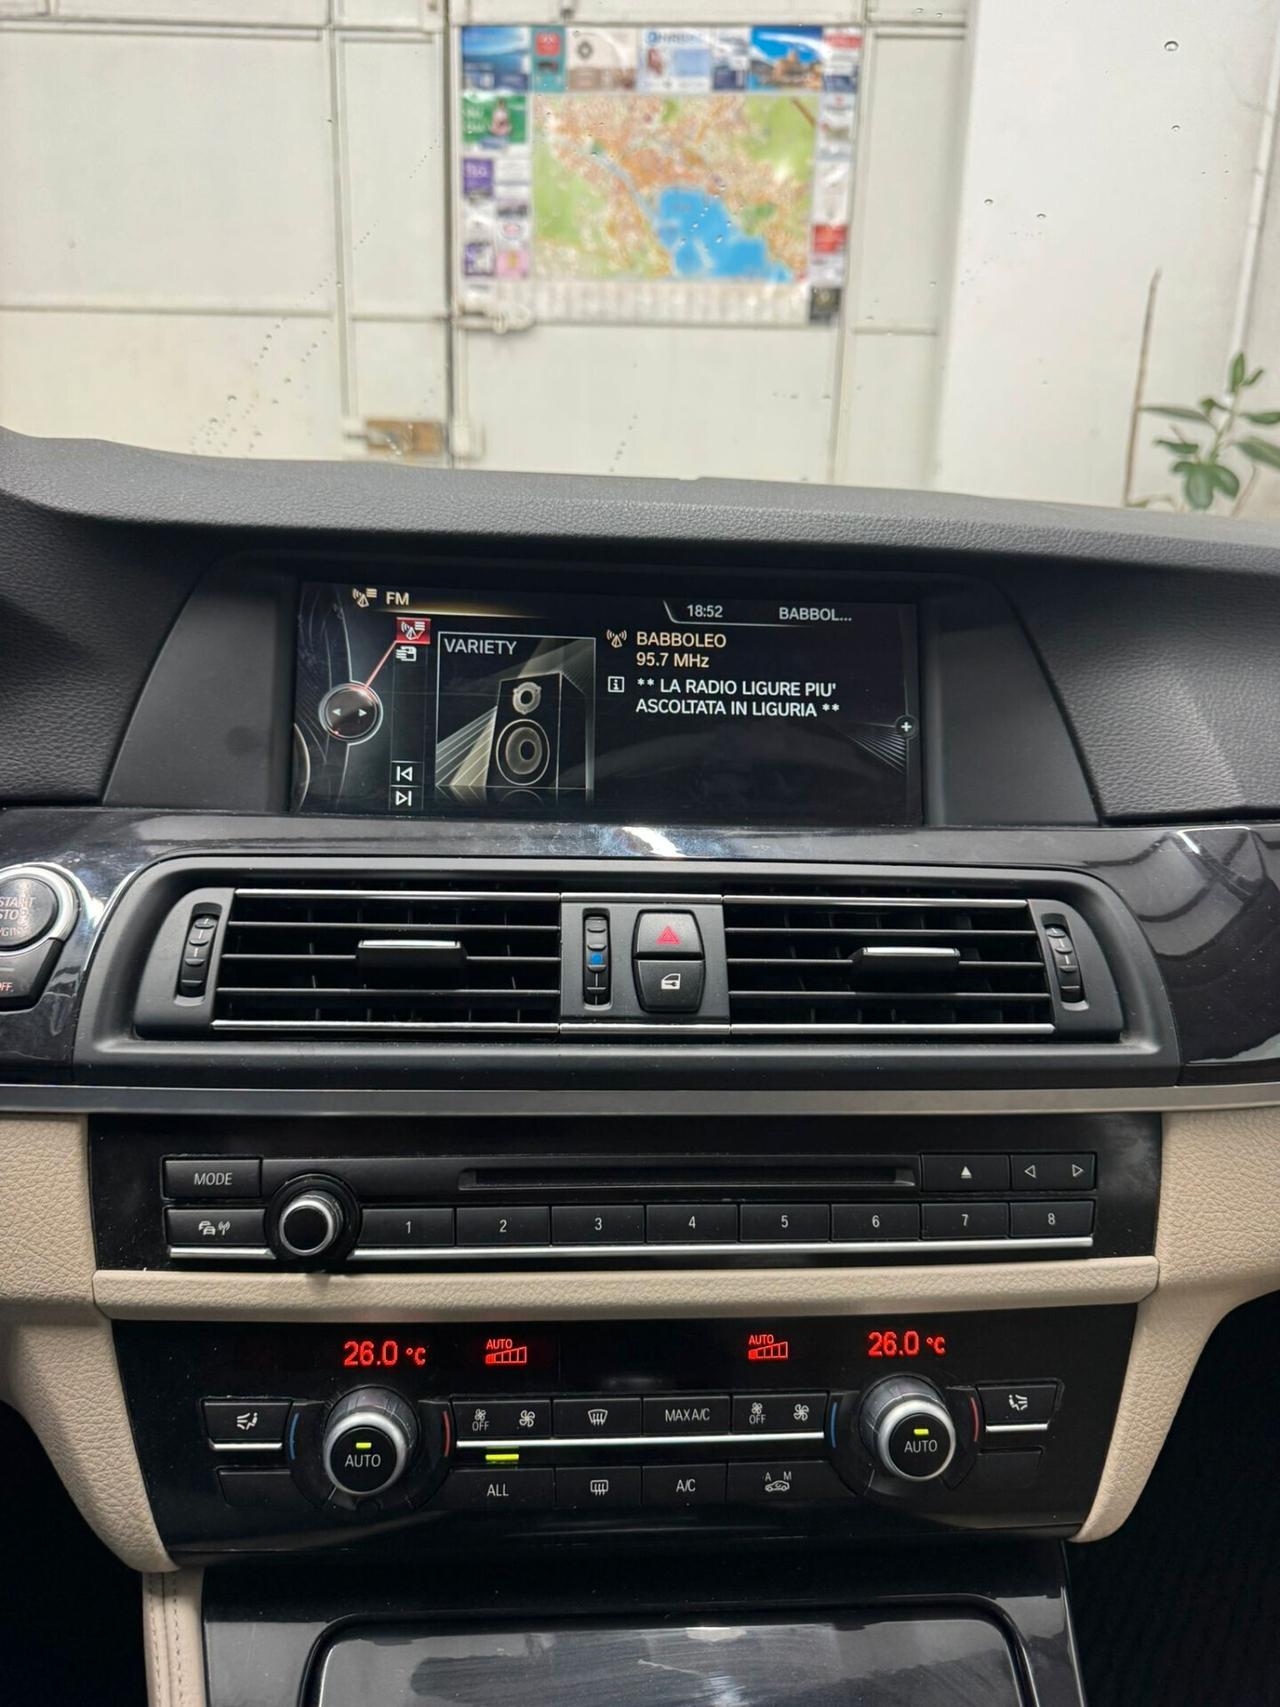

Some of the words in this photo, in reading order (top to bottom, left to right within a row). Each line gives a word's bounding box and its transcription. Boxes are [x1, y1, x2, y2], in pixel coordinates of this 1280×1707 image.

[386, 592, 409, 605] FM
[687, 605, 723, 617] 18:52
[779, 607, 852, 621] BABBOL...
[636, 631, 726, 648] BABBOLEO
[444, 638, 517, 655] VARIETY
[637, 652, 669, 667] 95.7
[674, 653, 709, 668] MHz
[661, 679, 682, 694] LA
[686, 680, 737, 695] RADIO
[742, 680, 801, 696] LIGURE
[806, 682, 836, 697] PIU'
[636, 700, 726, 715] ASCOLTATA
[732, 701, 747, 716] IN
[752, 701, 817, 717] LIGURIA
[194, 1172, 232, 1185] MODE
[499, 1220, 507, 1232] 2
[595, 1218, 602, 1230] 3
[688, 1216, 696, 1228] 4
[781, 1216, 788, 1228] 5
[872, 1215, 879, 1227] 6
[961, 1214, 968, 1226] 7
[1048, 1213, 1055, 1226] 8
[405, 1221, 411, 1233] 1
[486, 1339, 512, 1350] AUTO
[749, 1334, 774, 1345] AUTO
[868, 1331, 919, 1356] 26.0
[927, 1338, 946, 1355] °C
[344, 1341, 398, 1366] 26.0
[405, 1347, 426, 1366] °C
[665, 1409, 691, 1422] MAX
[692, 1408, 709, 1421] A/C
[749, 1415, 766, 1424] OFF
[472, 1421, 489, 1431] OFF
[904, 1440, 938, 1453] AUTO
[345, 1454, 381, 1467] AUTO
[764, 1473, 772, 1482] A
[783, 1471, 792, 1480] M
[487, 1485, 509, 1496] ALL
[676, 1479, 696, 1492] A/C
